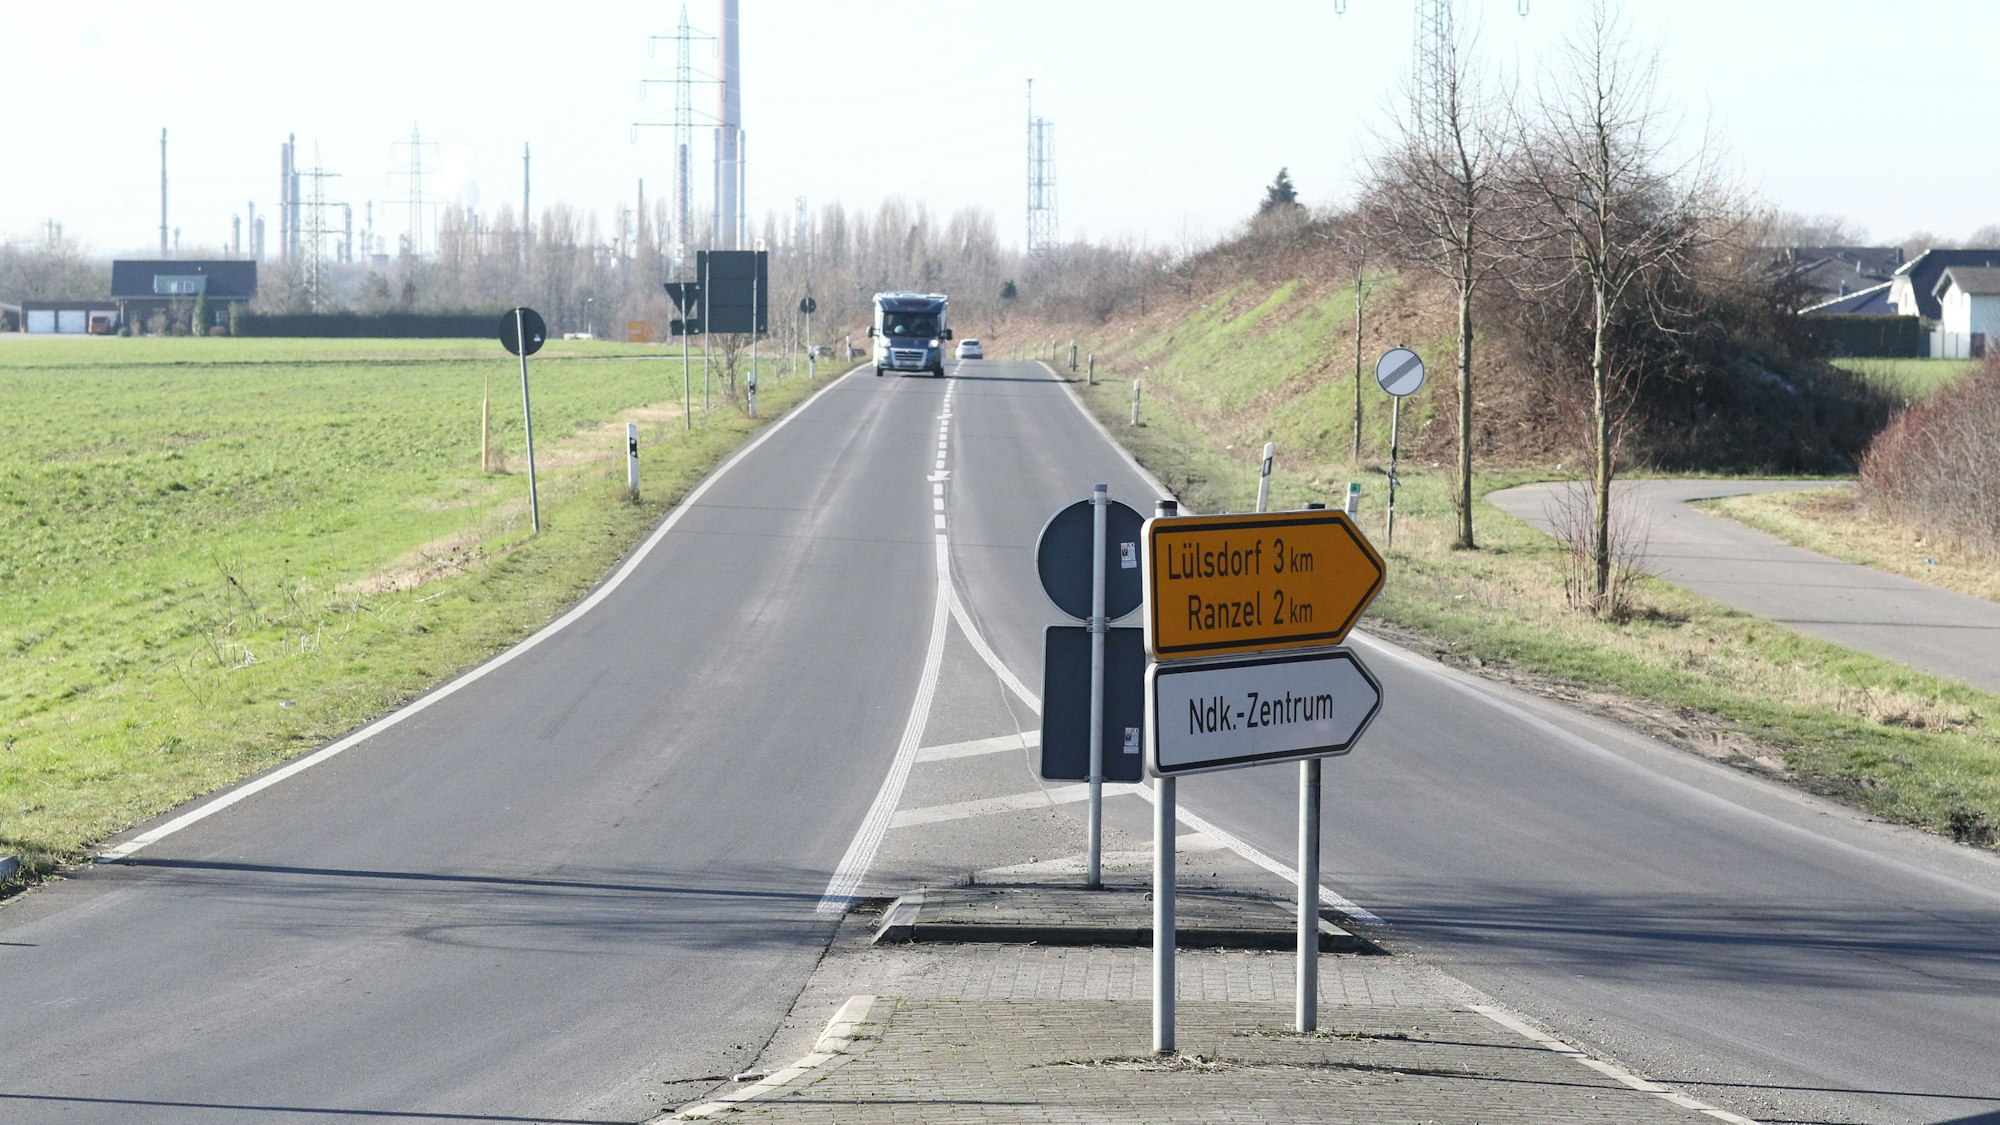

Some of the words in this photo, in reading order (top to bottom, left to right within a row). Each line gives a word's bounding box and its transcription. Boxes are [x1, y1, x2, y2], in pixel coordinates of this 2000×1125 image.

[1168, 539, 1262, 580] Lülsdorf
[1273, 538, 1284, 574] 3
[1290, 547, 1314, 573] km
[1188, 591, 1262, 631] Ranzel
[1273, 589, 1284, 625] 2
[1290, 598, 1313, 624] km
[1189, 691, 1333, 735] Ndk.-Zentrum
